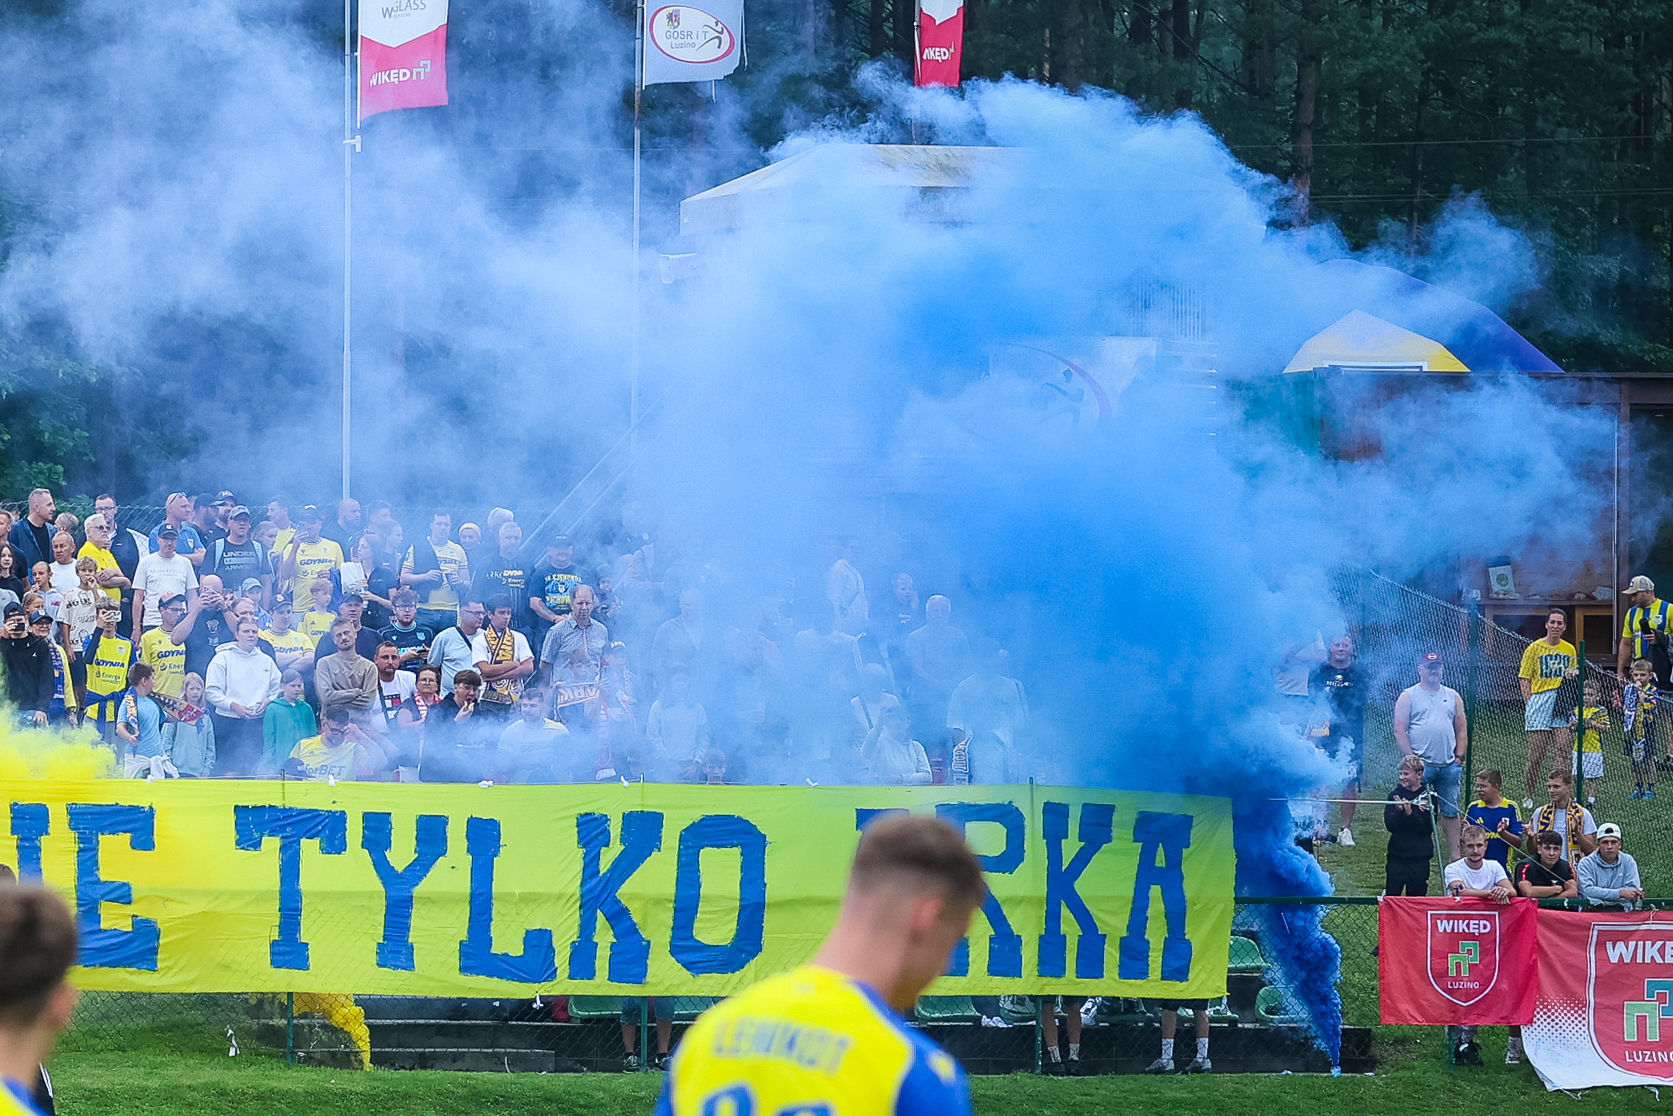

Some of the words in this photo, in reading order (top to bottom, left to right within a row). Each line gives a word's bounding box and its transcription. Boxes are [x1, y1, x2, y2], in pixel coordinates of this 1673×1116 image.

[665, 31, 693, 40] GOSR
[670, 41, 696, 49] Luzino
[95, 659, 125, 668] GDYNIA
[233, 803, 768, 985] TYLKO
[855, 801, 1193, 983] RKA
[1437, 919, 1491, 936] WIKĘD
[1447, 981, 1480, 989] LUZINO
